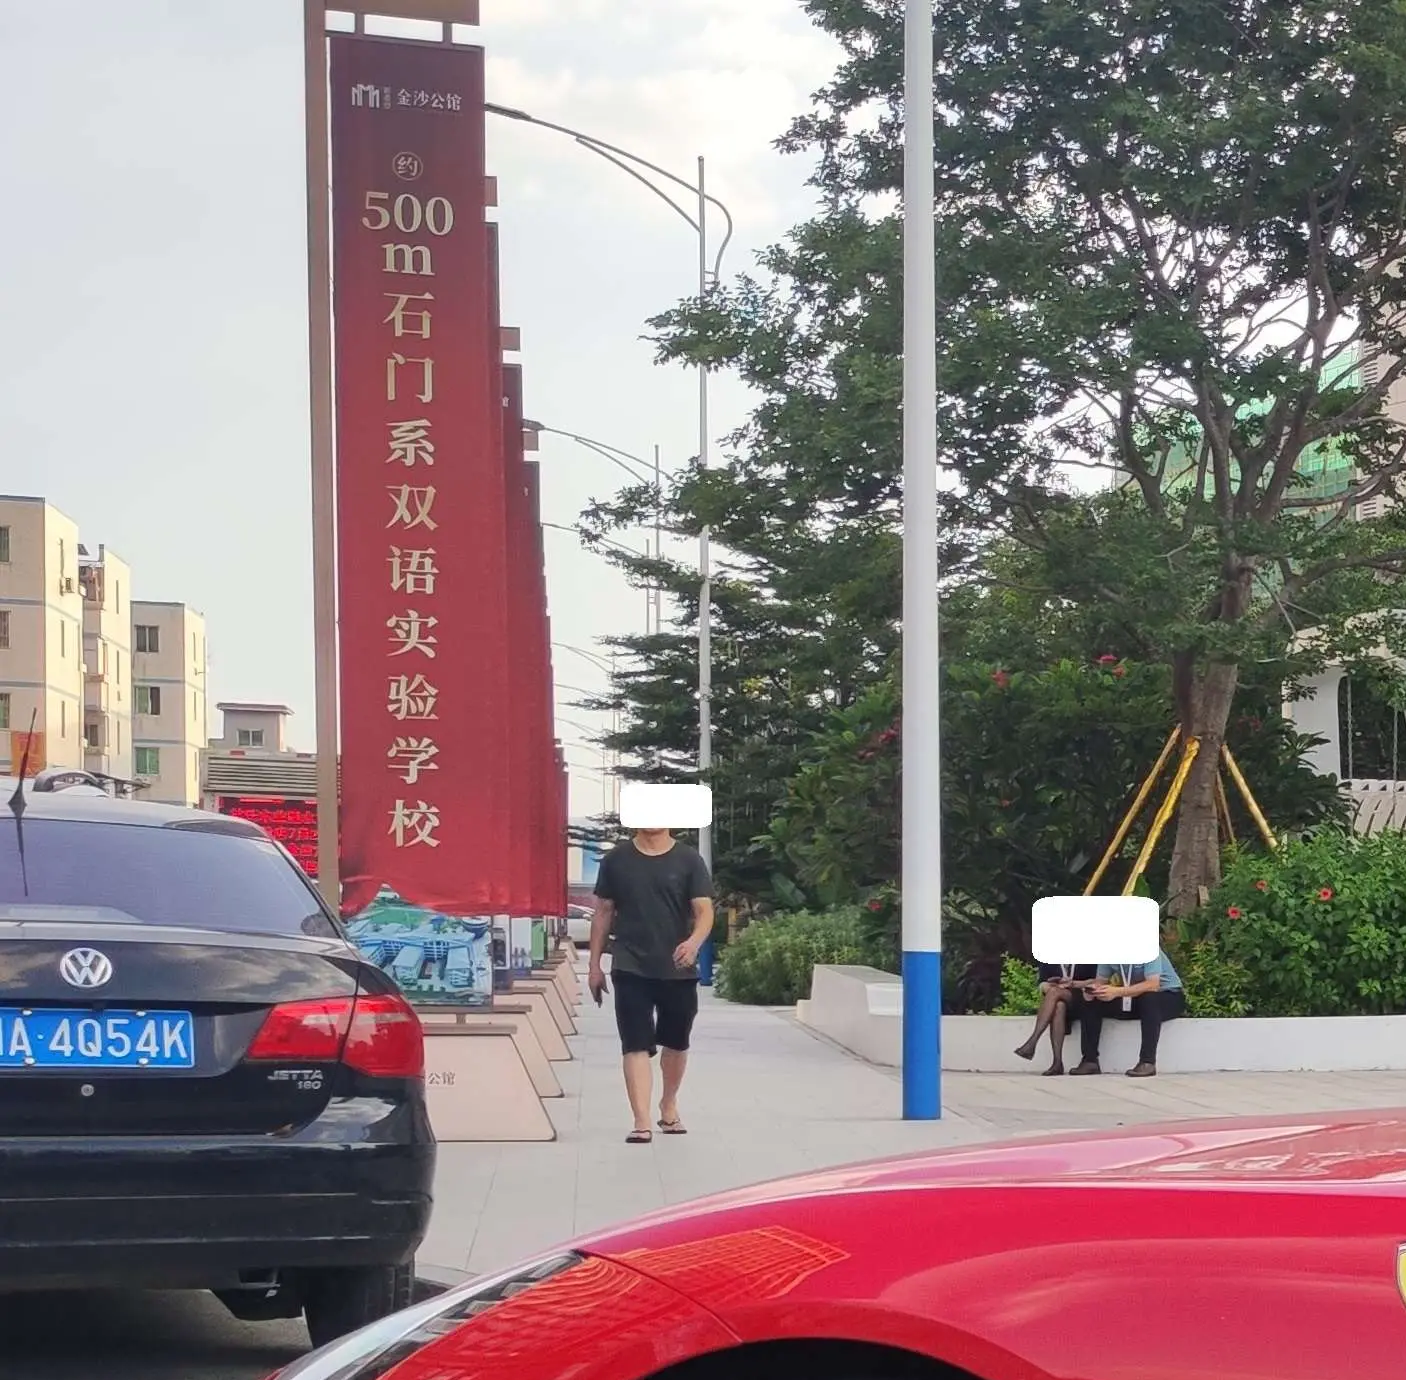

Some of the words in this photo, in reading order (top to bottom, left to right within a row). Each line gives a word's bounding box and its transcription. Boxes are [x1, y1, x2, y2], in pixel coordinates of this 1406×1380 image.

[397, 88, 463, 111] 金沙公馆
[396, 154, 419, 178] 约
[361, 191, 454, 237] 500
[382, 242, 435, 277] m
[382, 291, 442, 850] 石门系双语实验学校
[0, 1017, 188, 1059] A·4Q54K
[267, 1069, 323, 1081] JETTA
